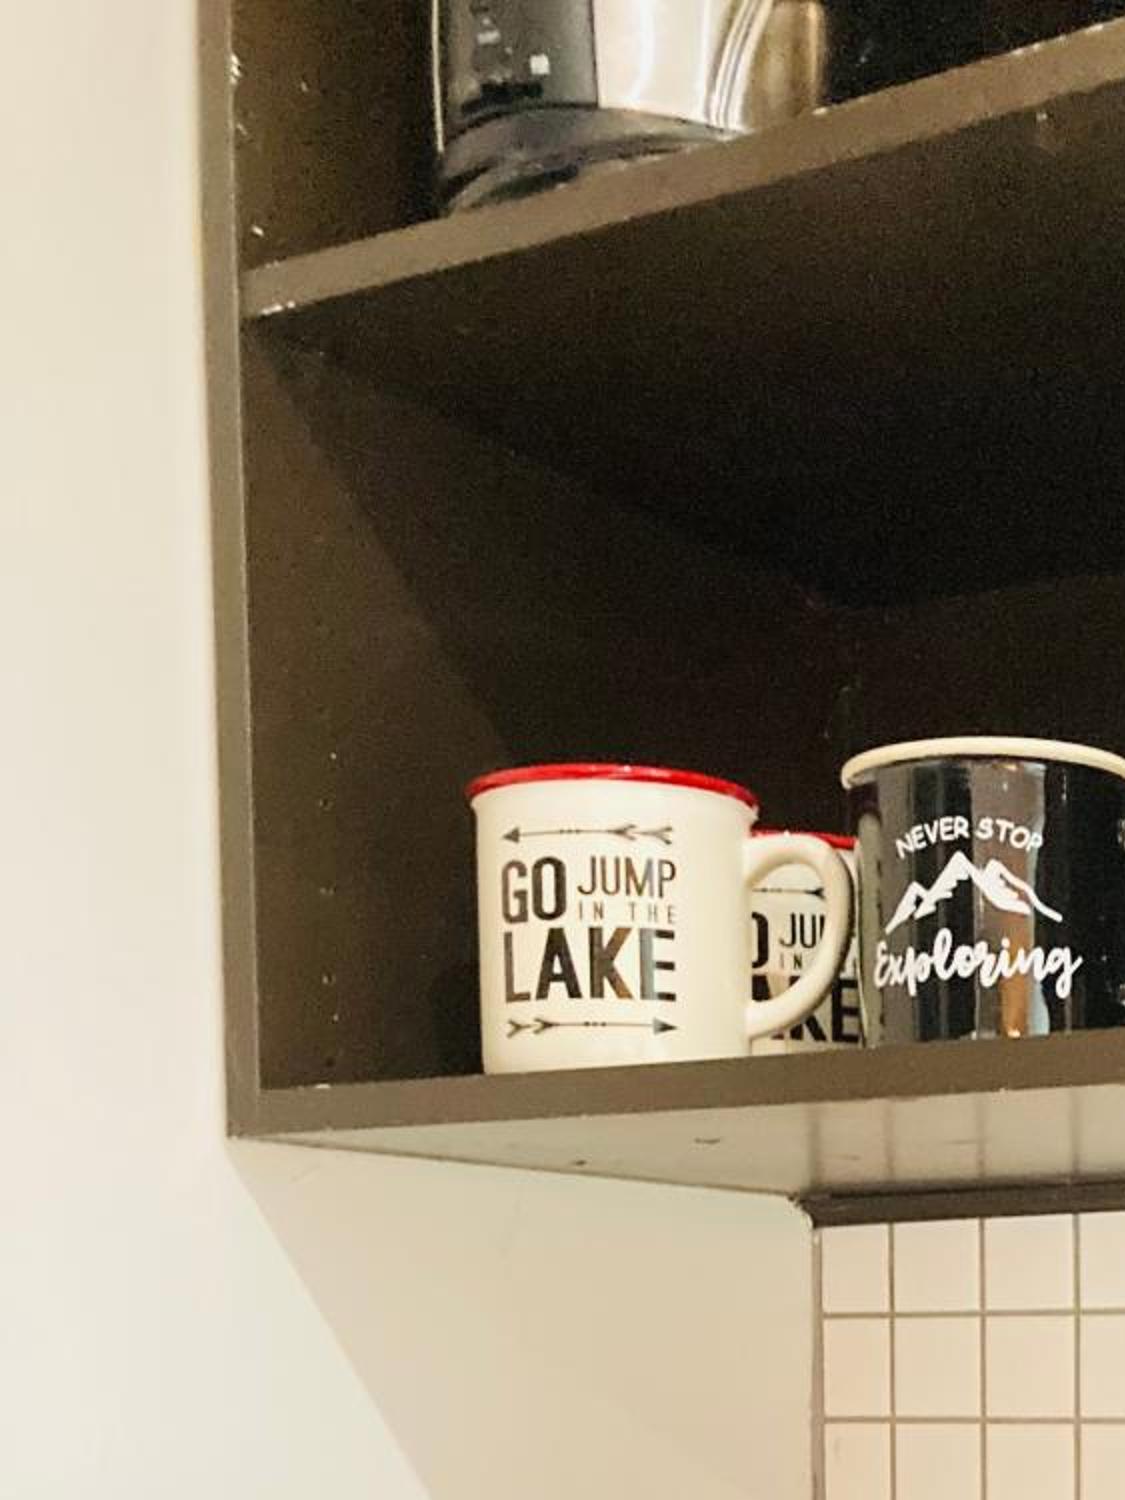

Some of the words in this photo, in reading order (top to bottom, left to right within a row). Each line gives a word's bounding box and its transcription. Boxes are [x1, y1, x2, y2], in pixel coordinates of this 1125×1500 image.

[895, 815, 970, 858] NEVER
[975, 817, 1043, 851] STOP
[501, 856, 567, 924] GO
[577, 855, 677, 898] JUMP
[578, 902, 605, 921] IN
[628, 902, 676, 924] THE
[503, 927, 677, 1004] LAKE
[873, 928, 1083, 999] Exploring
